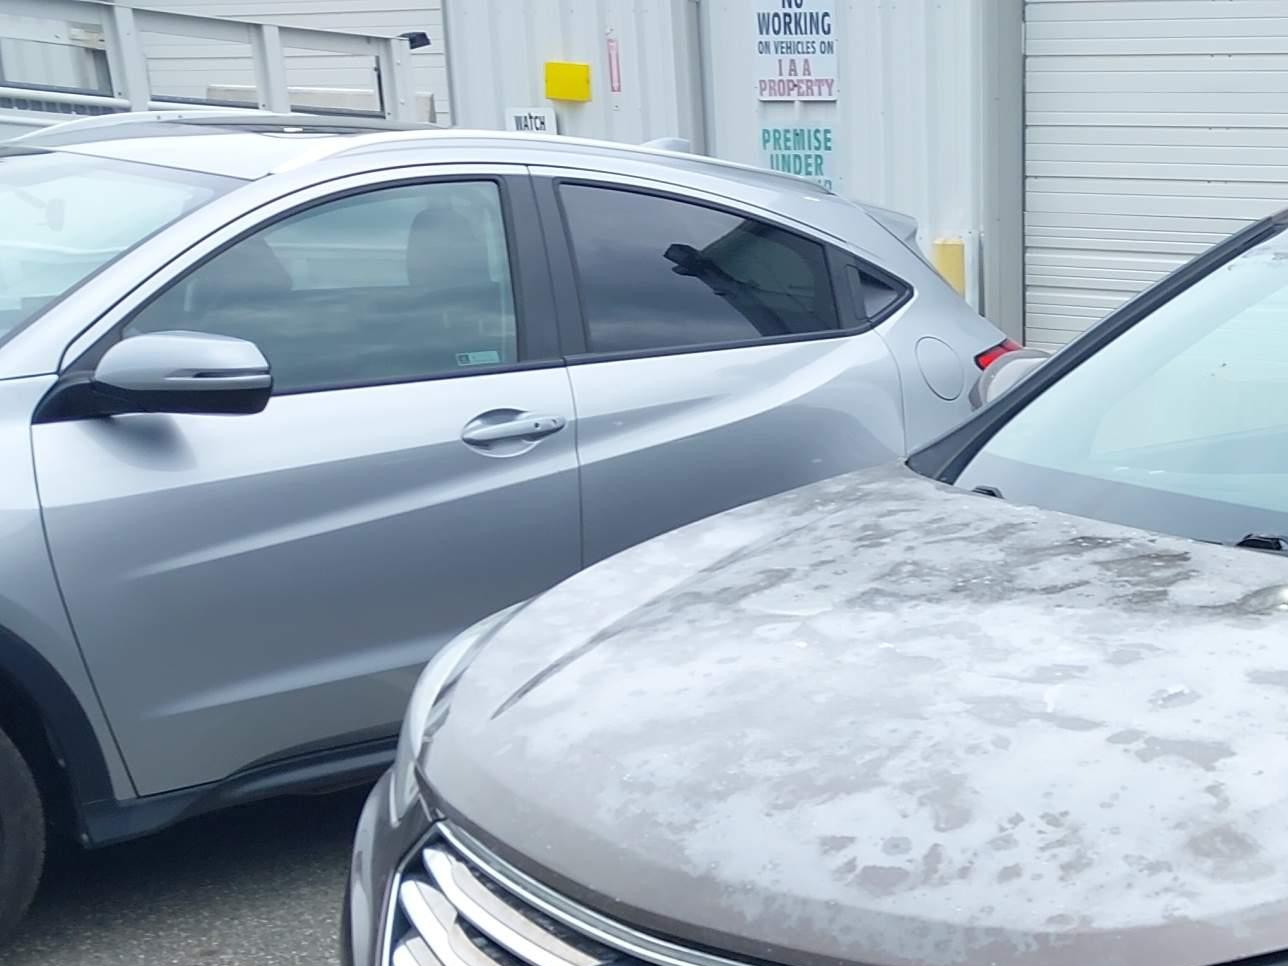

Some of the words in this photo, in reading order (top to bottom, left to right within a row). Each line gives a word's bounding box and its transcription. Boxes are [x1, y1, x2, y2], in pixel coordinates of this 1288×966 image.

[757, 12, 832, 36] WORKING
[758, 40, 771, 54] ON
[774, 40, 816, 54] VEHICLES
[819, 40, 834, 54] ON
[759, 78, 834, 97] PROPERTY
[514, 114, 546, 132] WATCH
[762, 128, 832, 151] PREMISE
[770, 153, 824, 176] UNDER
